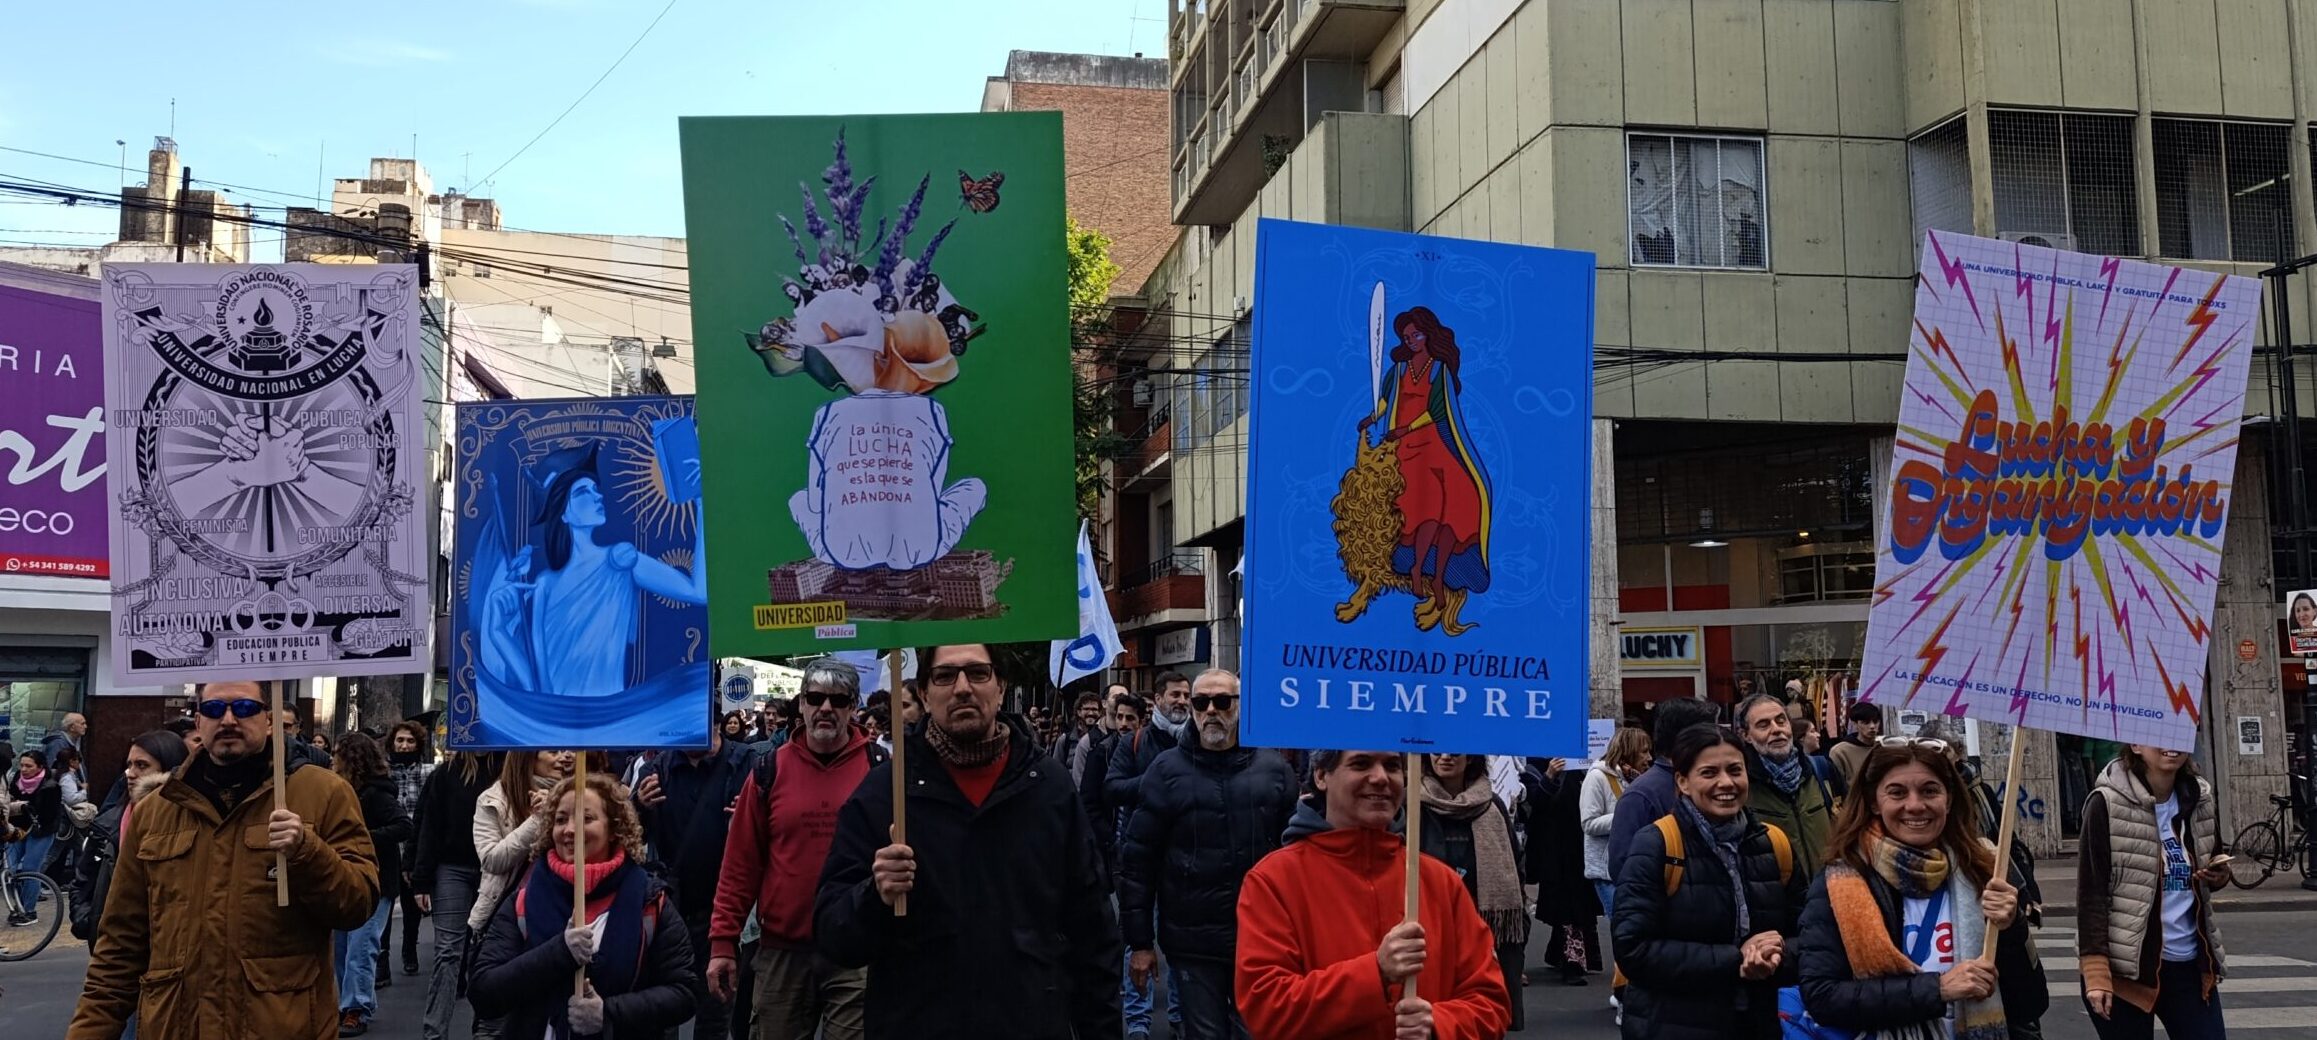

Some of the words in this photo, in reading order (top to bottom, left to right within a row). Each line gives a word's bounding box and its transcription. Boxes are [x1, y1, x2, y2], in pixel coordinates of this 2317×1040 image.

[240, 271, 296, 291] NACIONAL
[1962, 262, 1981, 273] UNA
[1983, 266, 2044, 281] UNIVERSIDAD
[2086, 282, 2112, 292] LAICA
[2122, 287, 2166, 300] GRATUITA
[2168, 294, 2194, 304] PARA
[294, 288, 309, 304] DE
[216, 282, 240, 350] UNIVERSIDAD
[291, 304, 313, 350] ROSARIO
[157, 333, 235, 391] UNIVERSIDAD
[240, 376, 303, 395] NACIONAL
[308, 368, 326, 385] EN
[327, 338, 364, 374] LUCHA
[113, 409, 218, 428] UNIVERSIDAD
[299, 410, 363, 427] PUBLICA
[526, 421, 571, 441] UNIVERSIDAD
[851, 424, 865, 436] la
[871, 422, 914, 439] única
[1943, 389, 2116, 482] Lucha
[2117, 416, 2167, 487] y
[338, 433, 401, 450] POPULAR
[849, 436, 913, 457] LUCHA
[836, 459, 861, 474] que
[861, 458, 876, 468] se
[878, 456, 913, 472] pierde
[849, 475, 863, 485] es
[864, 473, 876, 485] la
[878, 474, 900, 488] que
[901, 475, 914, 487] se
[841, 491, 913, 506] ABANDONA
[1890, 459, 2225, 565] Organización
[181, 518, 249, 534] FEMINISTA
[298, 526, 398, 544] COMUNITARIA
[29, 560, 40, 569] 54
[41, 561, 57, 570] 341
[58, 562, 75, 571] 589
[75, 563, 96, 572] 4292
[144, 577, 246, 601] INCLUSIVA
[314, 573, 369, 588] ACCESIBLE
[323, 595, 393, 615] DIVERSA
[119, 611, 225, 636] AUTONOMA
[756, 604, 844, 627] UNIVERSIDAD
[354, 629, 427, 649] GRATUITA
[817, 625, 855, 638] Pública
[226, 637, 278, 650] EDUCACION
[281, 636, 321, 648] PUBLICA
[240, 650, 308, 663] SIEMPRE
[1282, 643, 1447, 675] UNIVERSIDAD
[1453, 648, 1551, 681] PÚBLICA
[1279, 677, 1552, 720] SIEMPRE
[1895, 670, 1908, 680] LA
[1976, 682, 1989, 692] ES
[1991, 685, 2007, 695] UN
[2065, 697, 2082, 707] NO
[2084, 700, 2101, 710] UN
[2103, 702, 2164, 720] PRIVILEGIO
